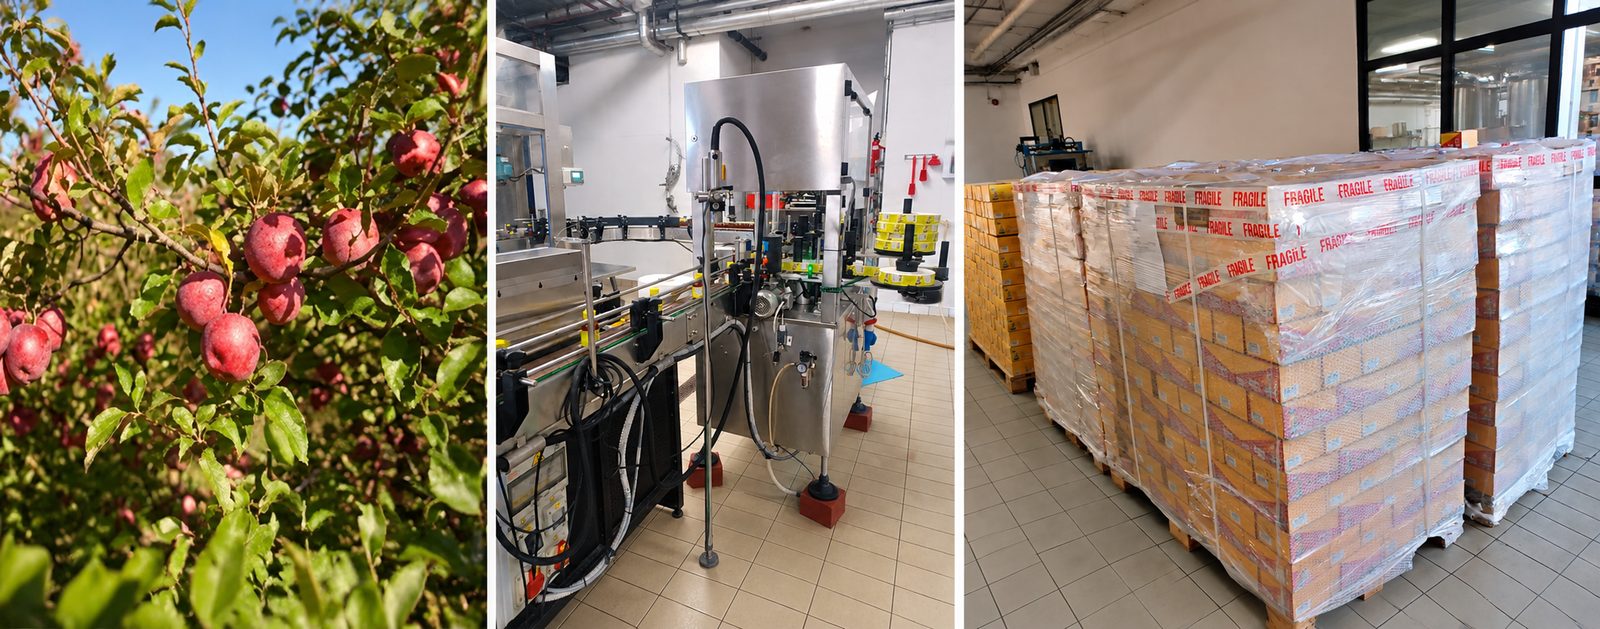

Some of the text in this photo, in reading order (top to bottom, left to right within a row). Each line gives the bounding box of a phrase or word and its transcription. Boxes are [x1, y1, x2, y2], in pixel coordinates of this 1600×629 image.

[1164, 191, 1186, 204] FRAGILE
[1194, 191, 1222, 206] FRAGILE
[1232, 191, 1267, 208] FRAGILE
[1283, 187, 1325, 207] FRAGILE
[1337, 180, 1375, 199] FRAGILE
[1206, 220, 1233, 237] FRAGILE
[1242, 223, 1281, 239] FRAGILE
[1196, 269, 1221, 290] FRAGILE
[1226, 257, 1256, 279] FRAGILE
[1265, 246, 1308, 271] FRAGILE
